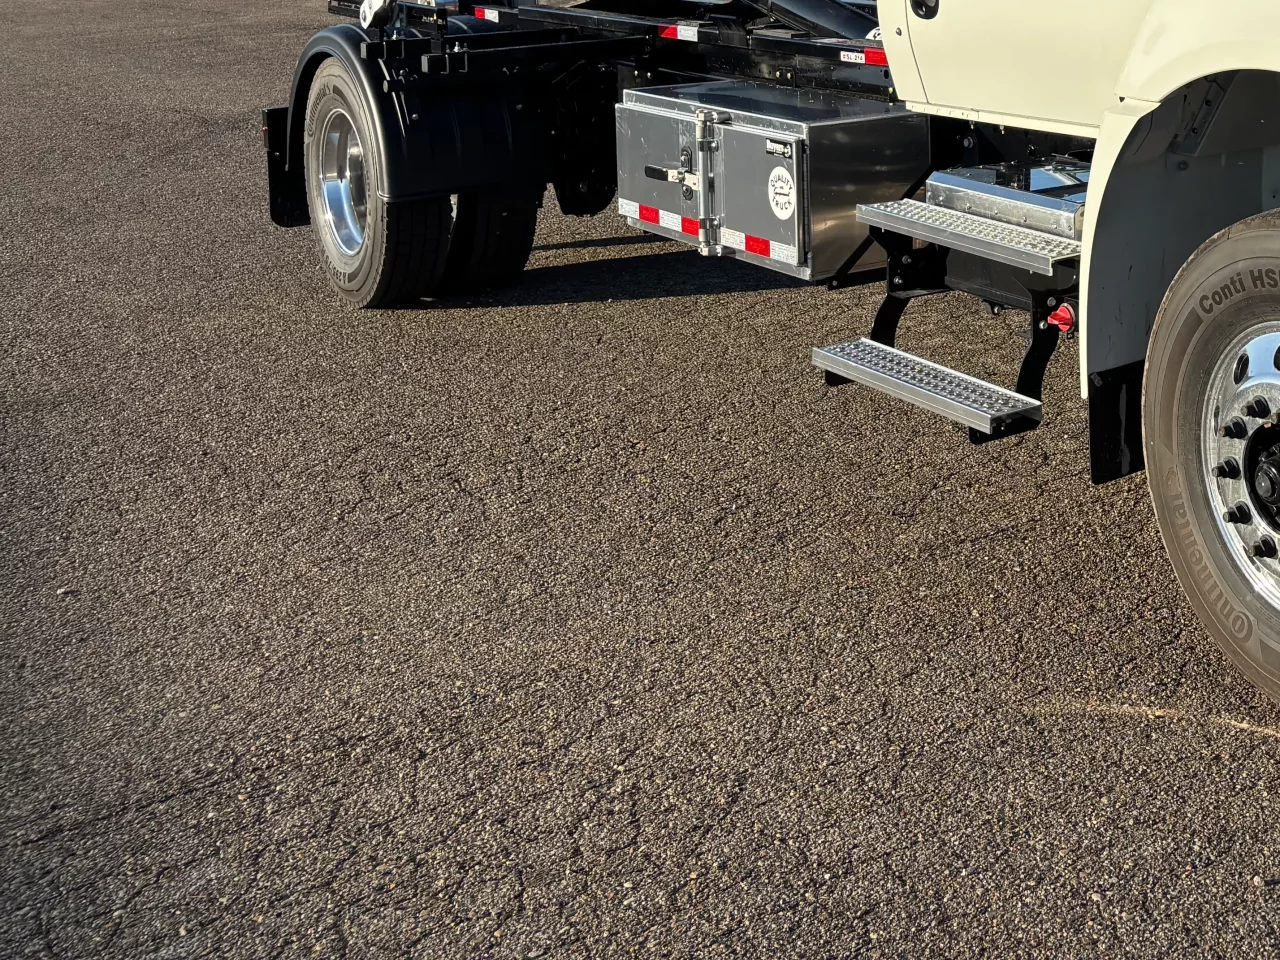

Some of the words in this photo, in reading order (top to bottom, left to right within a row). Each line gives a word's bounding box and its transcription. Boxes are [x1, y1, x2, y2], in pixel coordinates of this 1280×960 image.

[770, 173, 793, 190] QUALITY
[772, 195, 792, 210] TRUCK
[1199, 272, 1246, 314] Conti
[1169, 493, 1253, 644] Continental
